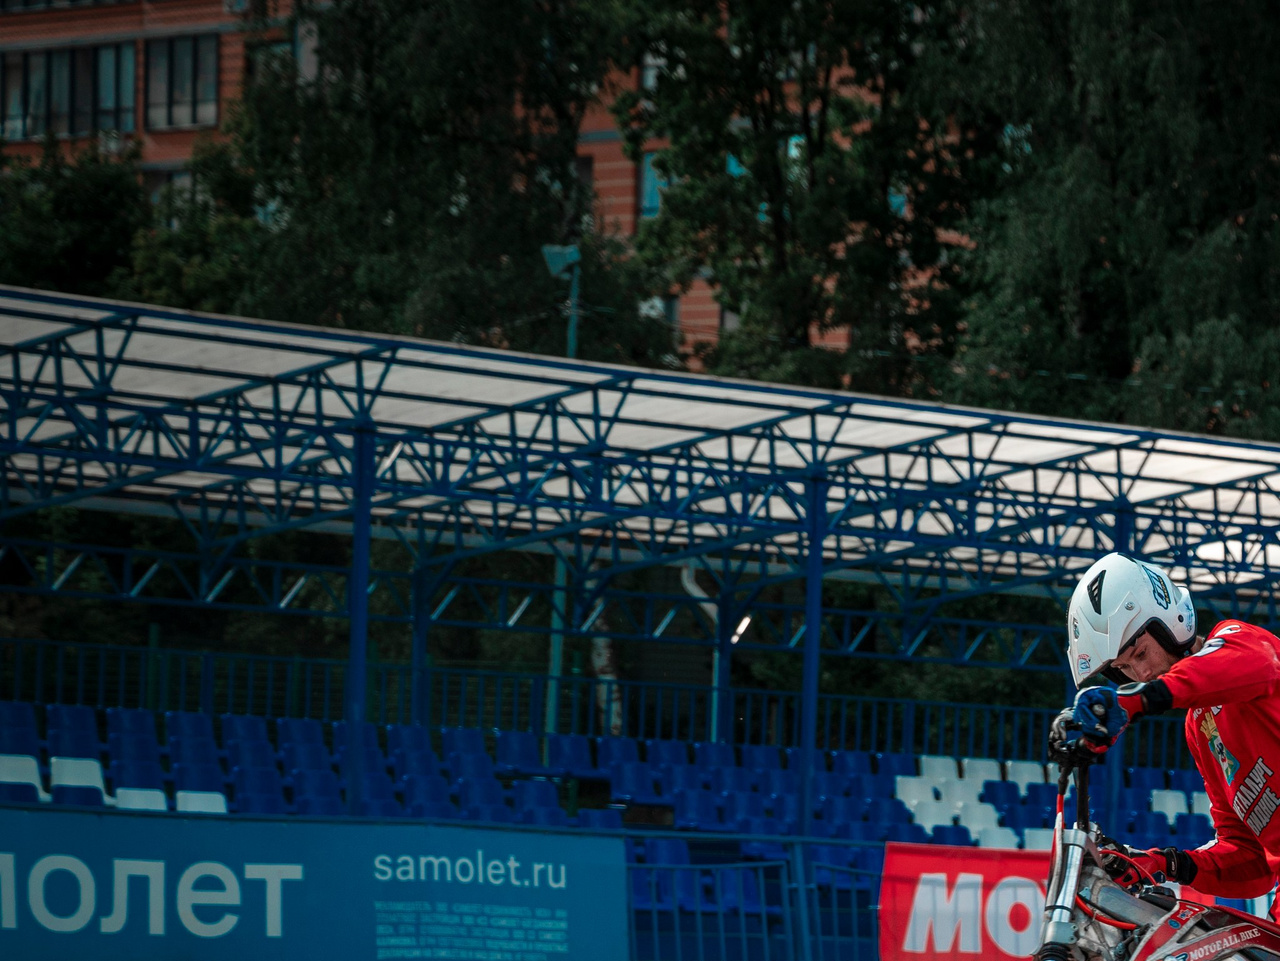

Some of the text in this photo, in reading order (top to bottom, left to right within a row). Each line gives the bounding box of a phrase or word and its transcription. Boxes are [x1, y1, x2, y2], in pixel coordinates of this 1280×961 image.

[0, 851, 303, 938] олет
[373, 850, 567, 889] samolet.ru
[902, 872, 1048, 958] MO
[1240, 928, 1261, 943] BIKE
